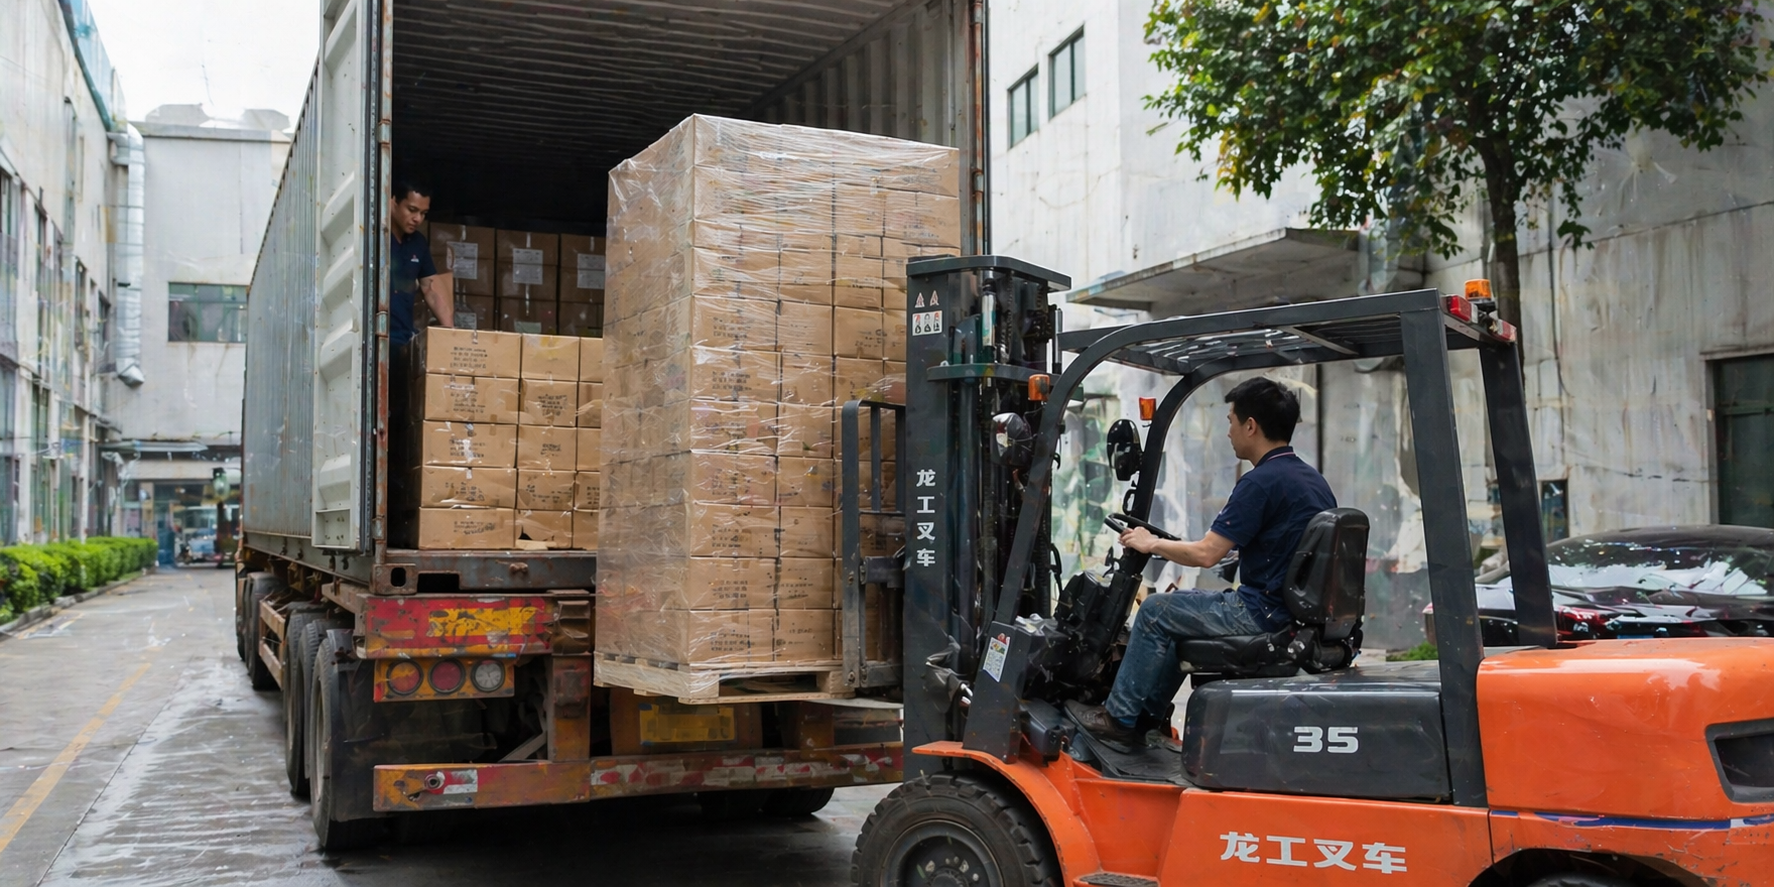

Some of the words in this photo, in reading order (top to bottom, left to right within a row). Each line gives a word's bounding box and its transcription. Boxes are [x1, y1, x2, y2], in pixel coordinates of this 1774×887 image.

[916, 469, 935, 567] 龙工叉车
[1293, 726, 1359, 754] 35
[1219, 831, 1408, 874] 龙工叉车
